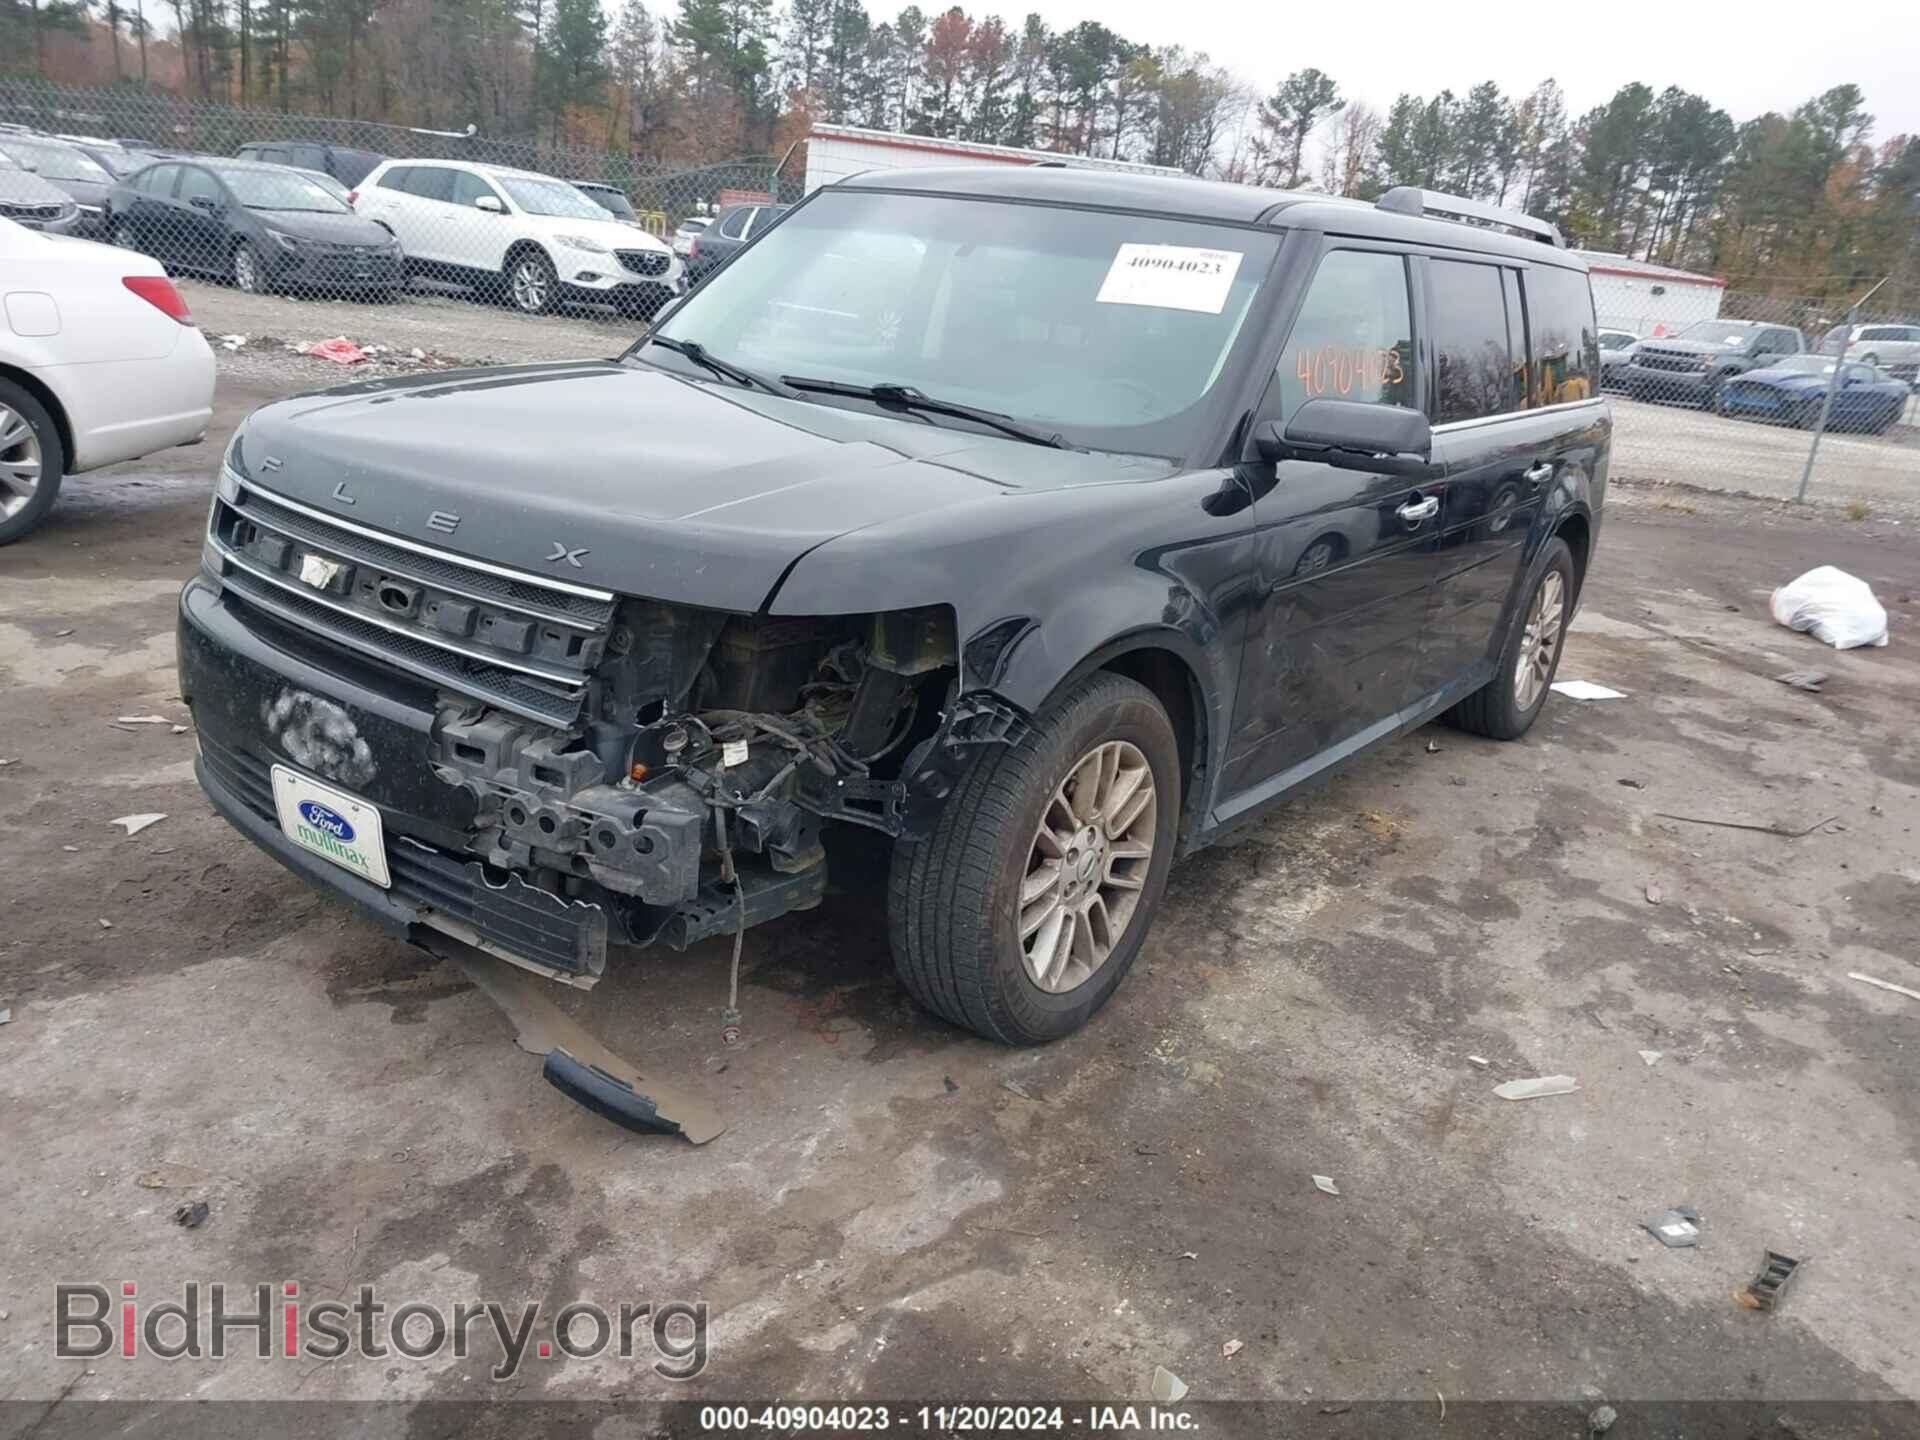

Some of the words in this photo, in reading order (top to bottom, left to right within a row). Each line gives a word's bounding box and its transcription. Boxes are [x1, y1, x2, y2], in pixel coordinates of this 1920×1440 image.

[1127, 257, 1222, 275] 40904023
[259, 455, 591, 568] FLEX
[309, 805, 345, 836] Ford
